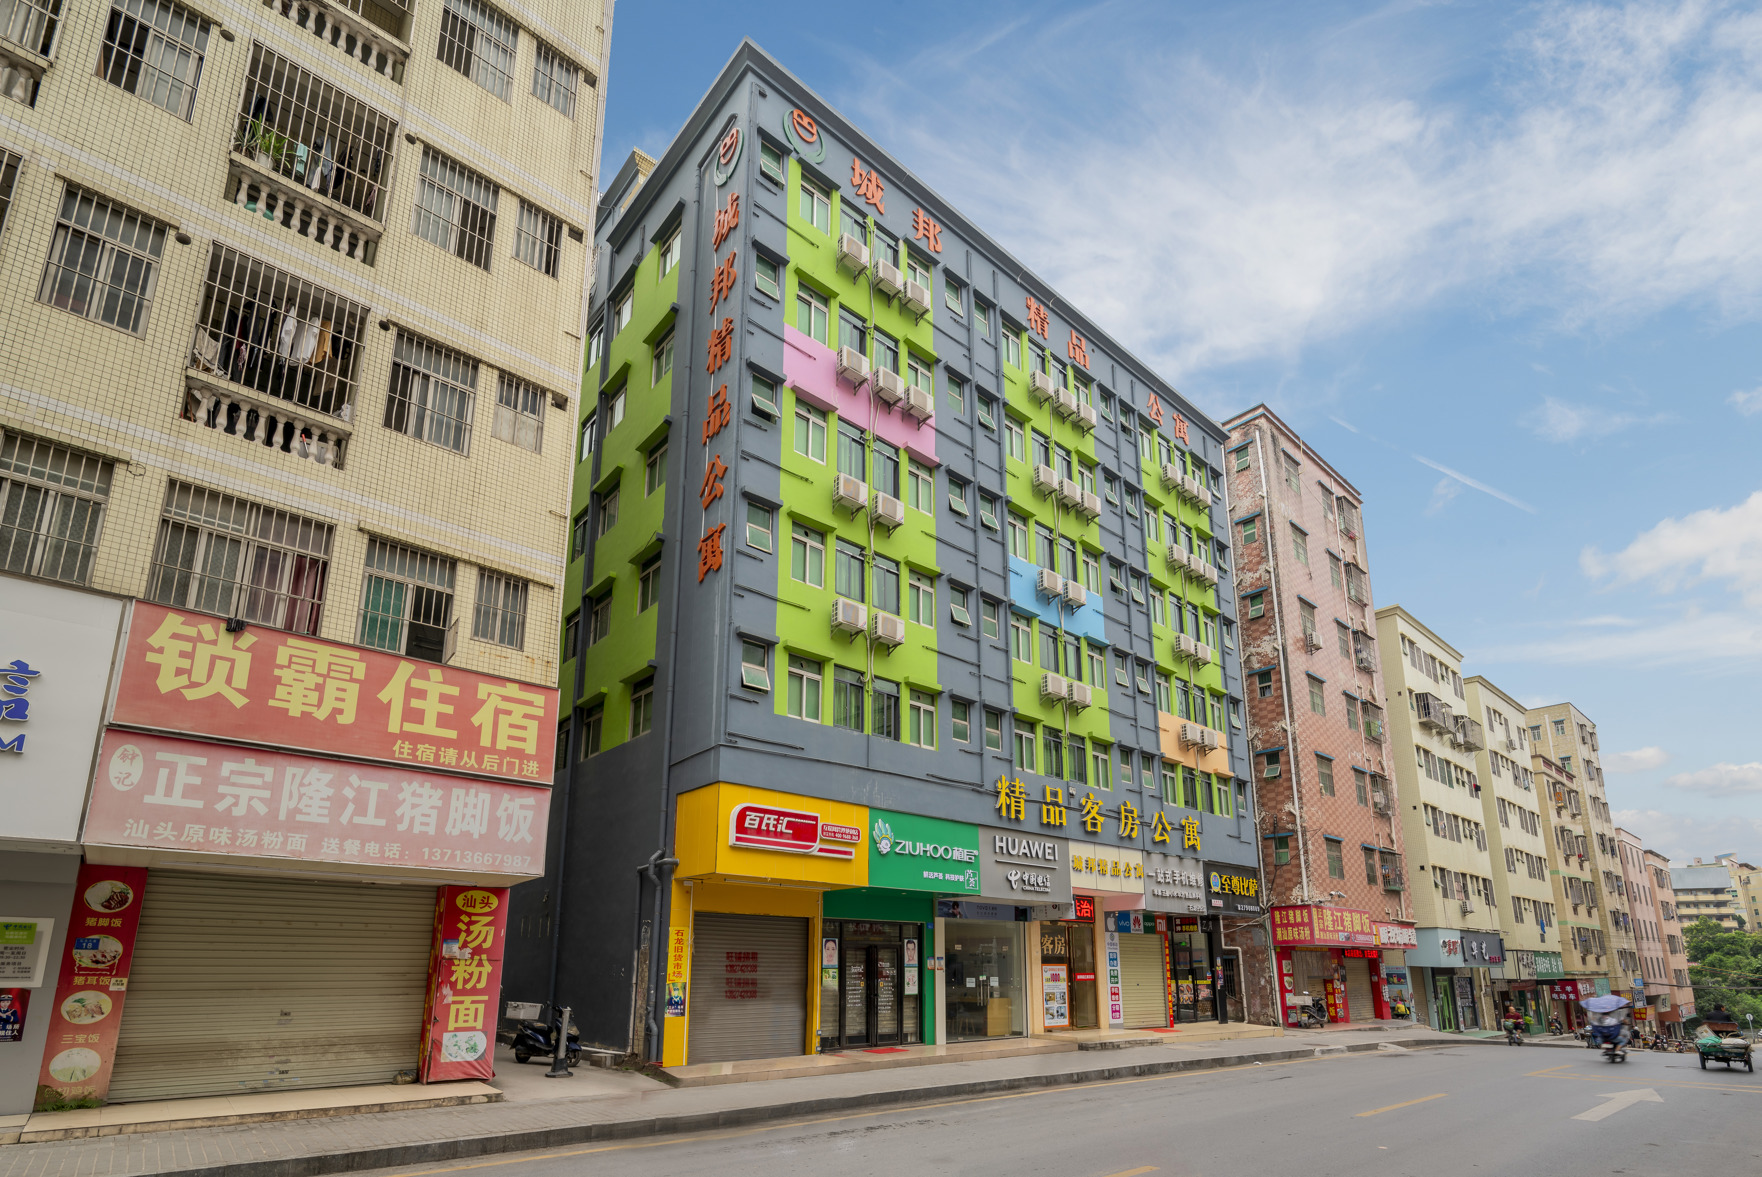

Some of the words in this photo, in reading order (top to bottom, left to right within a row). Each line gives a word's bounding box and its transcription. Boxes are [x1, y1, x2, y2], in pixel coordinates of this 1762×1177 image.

[851, 157, 942, 254] 城邦
[1025, 296, 1090, 370] 精品
[1147, 391, 1190, 446] 公寓
[698, 191, 740, 583] 城邦精品公寓
[146, 611, 546, 755] 锁霸住宿
[393, 739, 540, 778] 住宿请从后门进
[144, 750, 536, 843] 正宗隆江猪脚饭
[995, 774, 1201, 851] 精品客房公寓
[123, 818, 309, 853] 汕头原味汤粉面
[994, 835, 1058, 861] HUAWEI
[421, 846, 532, 868] 13713667987
[895, 840, 952, 859] ZIUHOO
[1022, 871, 1051, 887] 中国电信
[1072, 855, 1144, 879] 城邦精品公寓
[1221, 874, 1259, 898] 至尊比萨
[462, 893, 494, 910] 汕头
[85, 916, 122, 928] 猪脚饭
[1323, 909, 1371, 934] 隆江猪脚饭
[672, 929, 684, 978] 石龙旧货市场
[1041, 934, 1066, 955] 客房
[73, 975, 111, 986] 猪耳饭
[447, 913, 495, 1032] 汤粉面
[60, 1033, 101, 1044] 三宝饭
